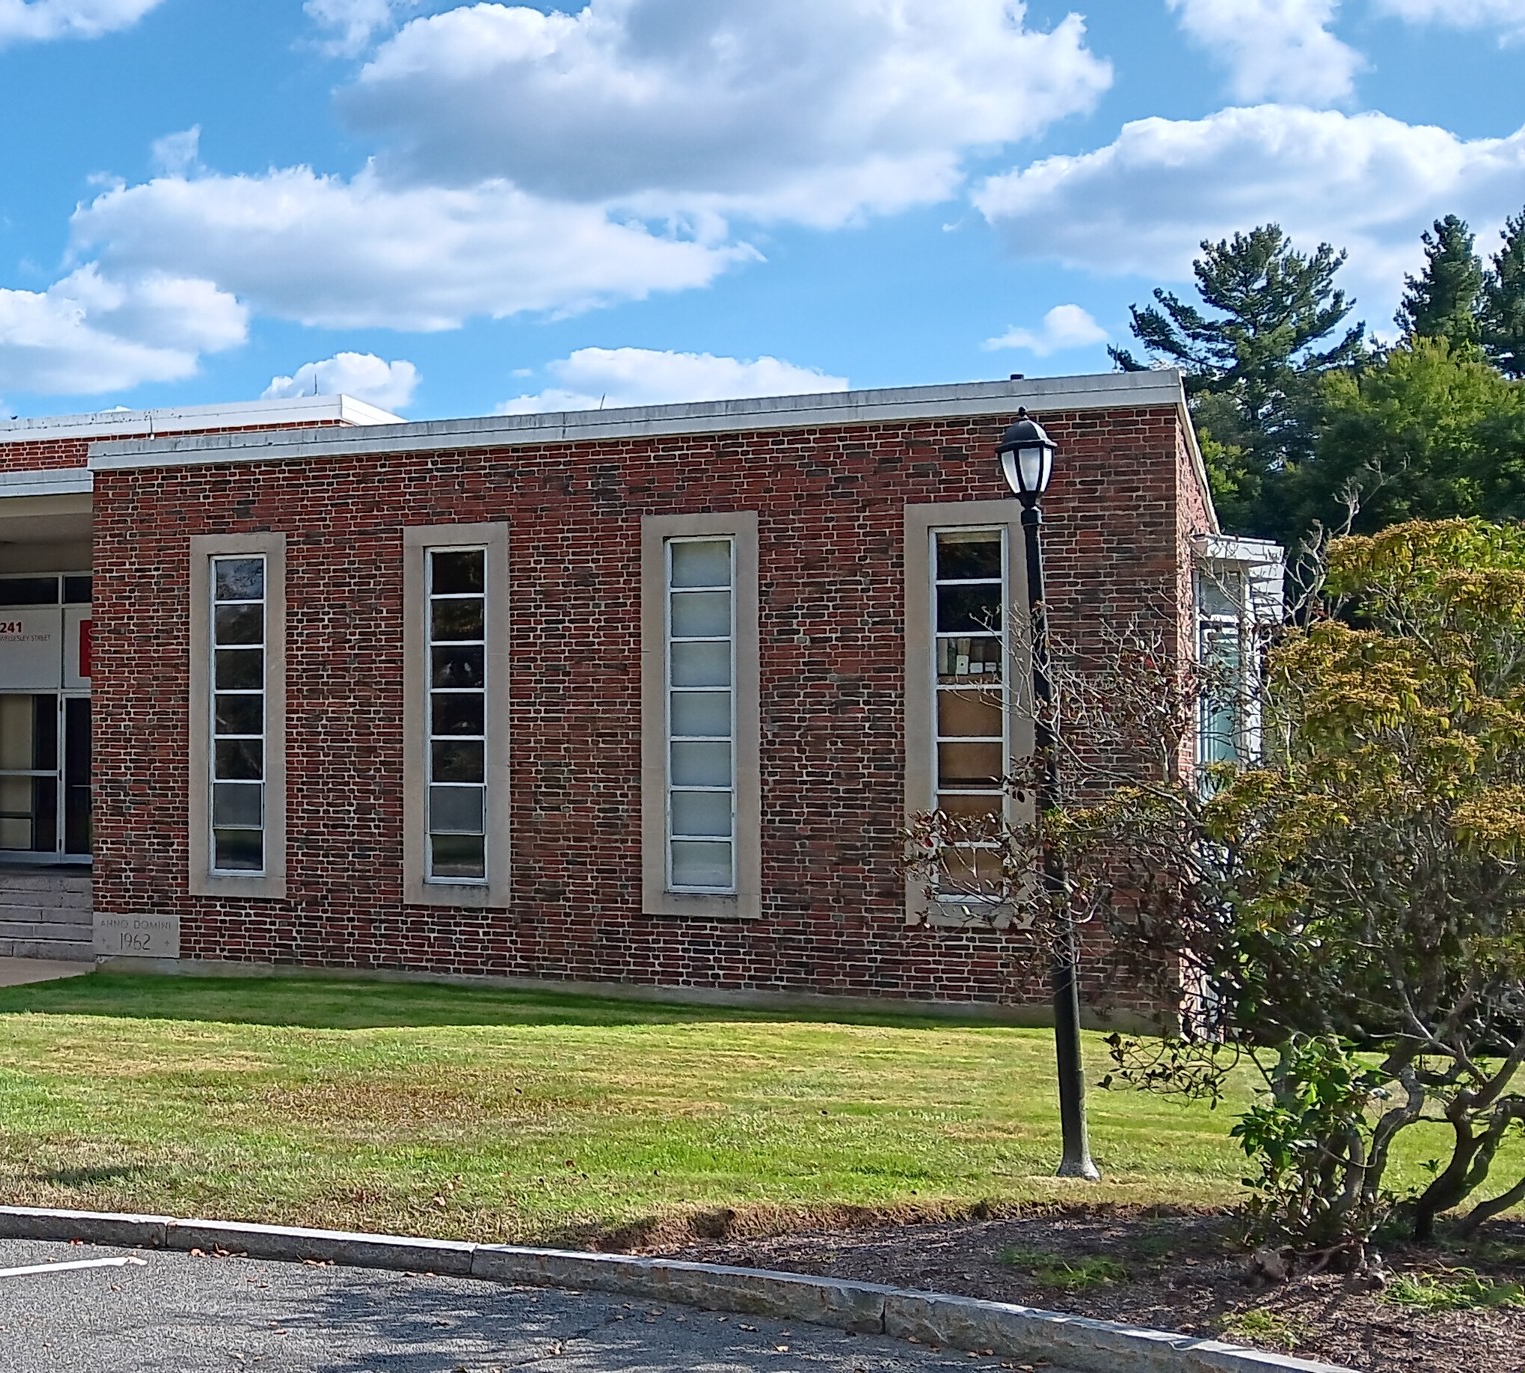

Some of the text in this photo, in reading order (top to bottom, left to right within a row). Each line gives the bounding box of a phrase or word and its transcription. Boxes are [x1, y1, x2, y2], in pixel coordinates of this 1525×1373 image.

[0, 621, 22, 634] 241
[100, 920, 171, 931] ANNO DOMINI
[120, 932, 151, 951] 1962
